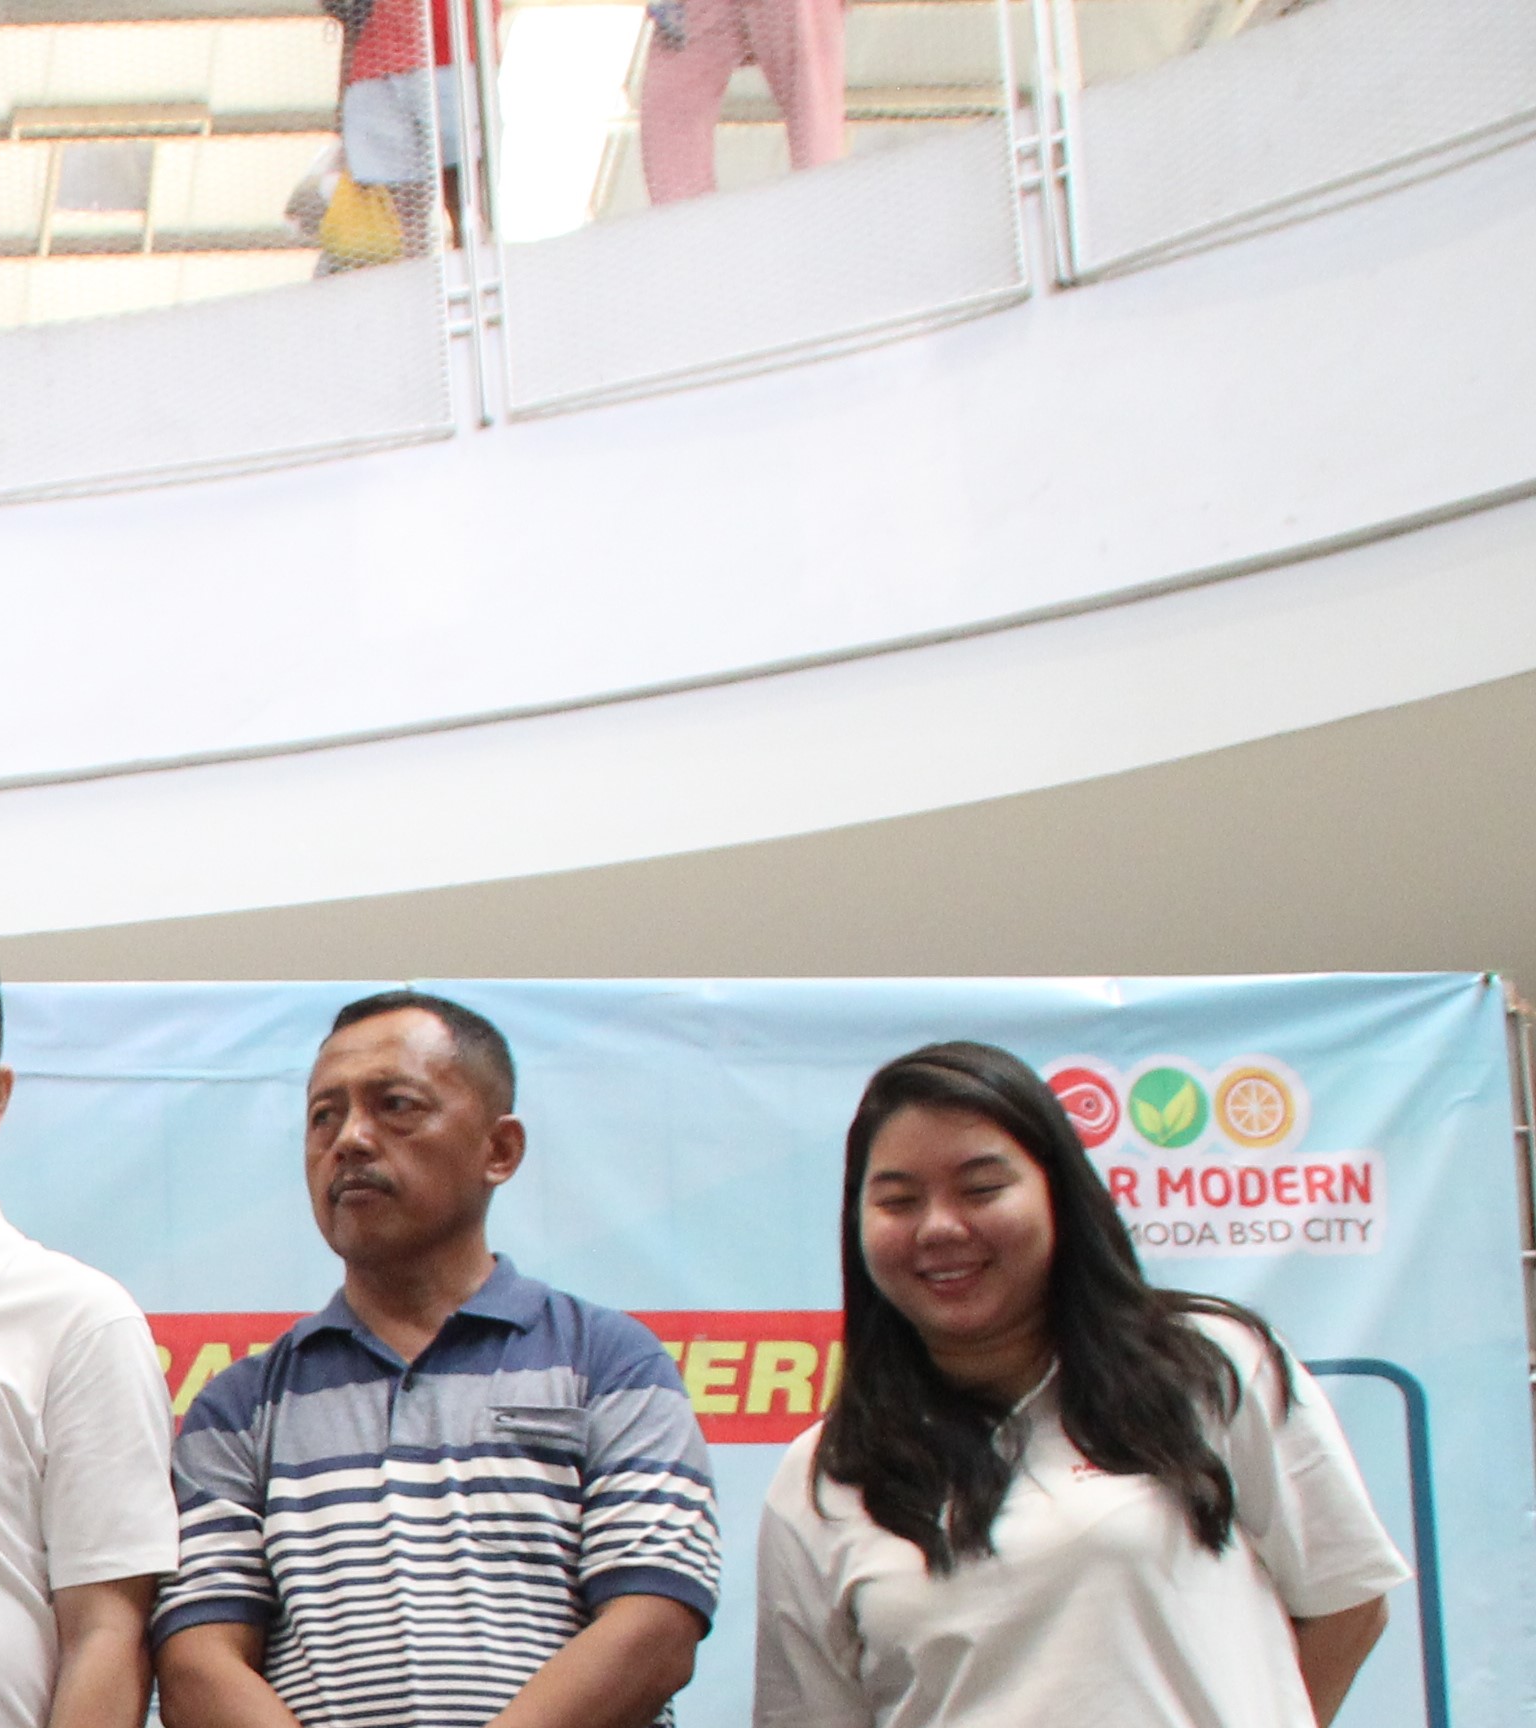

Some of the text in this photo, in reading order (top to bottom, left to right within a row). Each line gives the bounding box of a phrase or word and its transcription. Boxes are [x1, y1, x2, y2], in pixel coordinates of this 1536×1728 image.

[1157, 1164, 1372, 1207] MODERN
[1229, 1218, 1293, 1246] BSD
[1302, 1216, 1373, 1243] CITY
